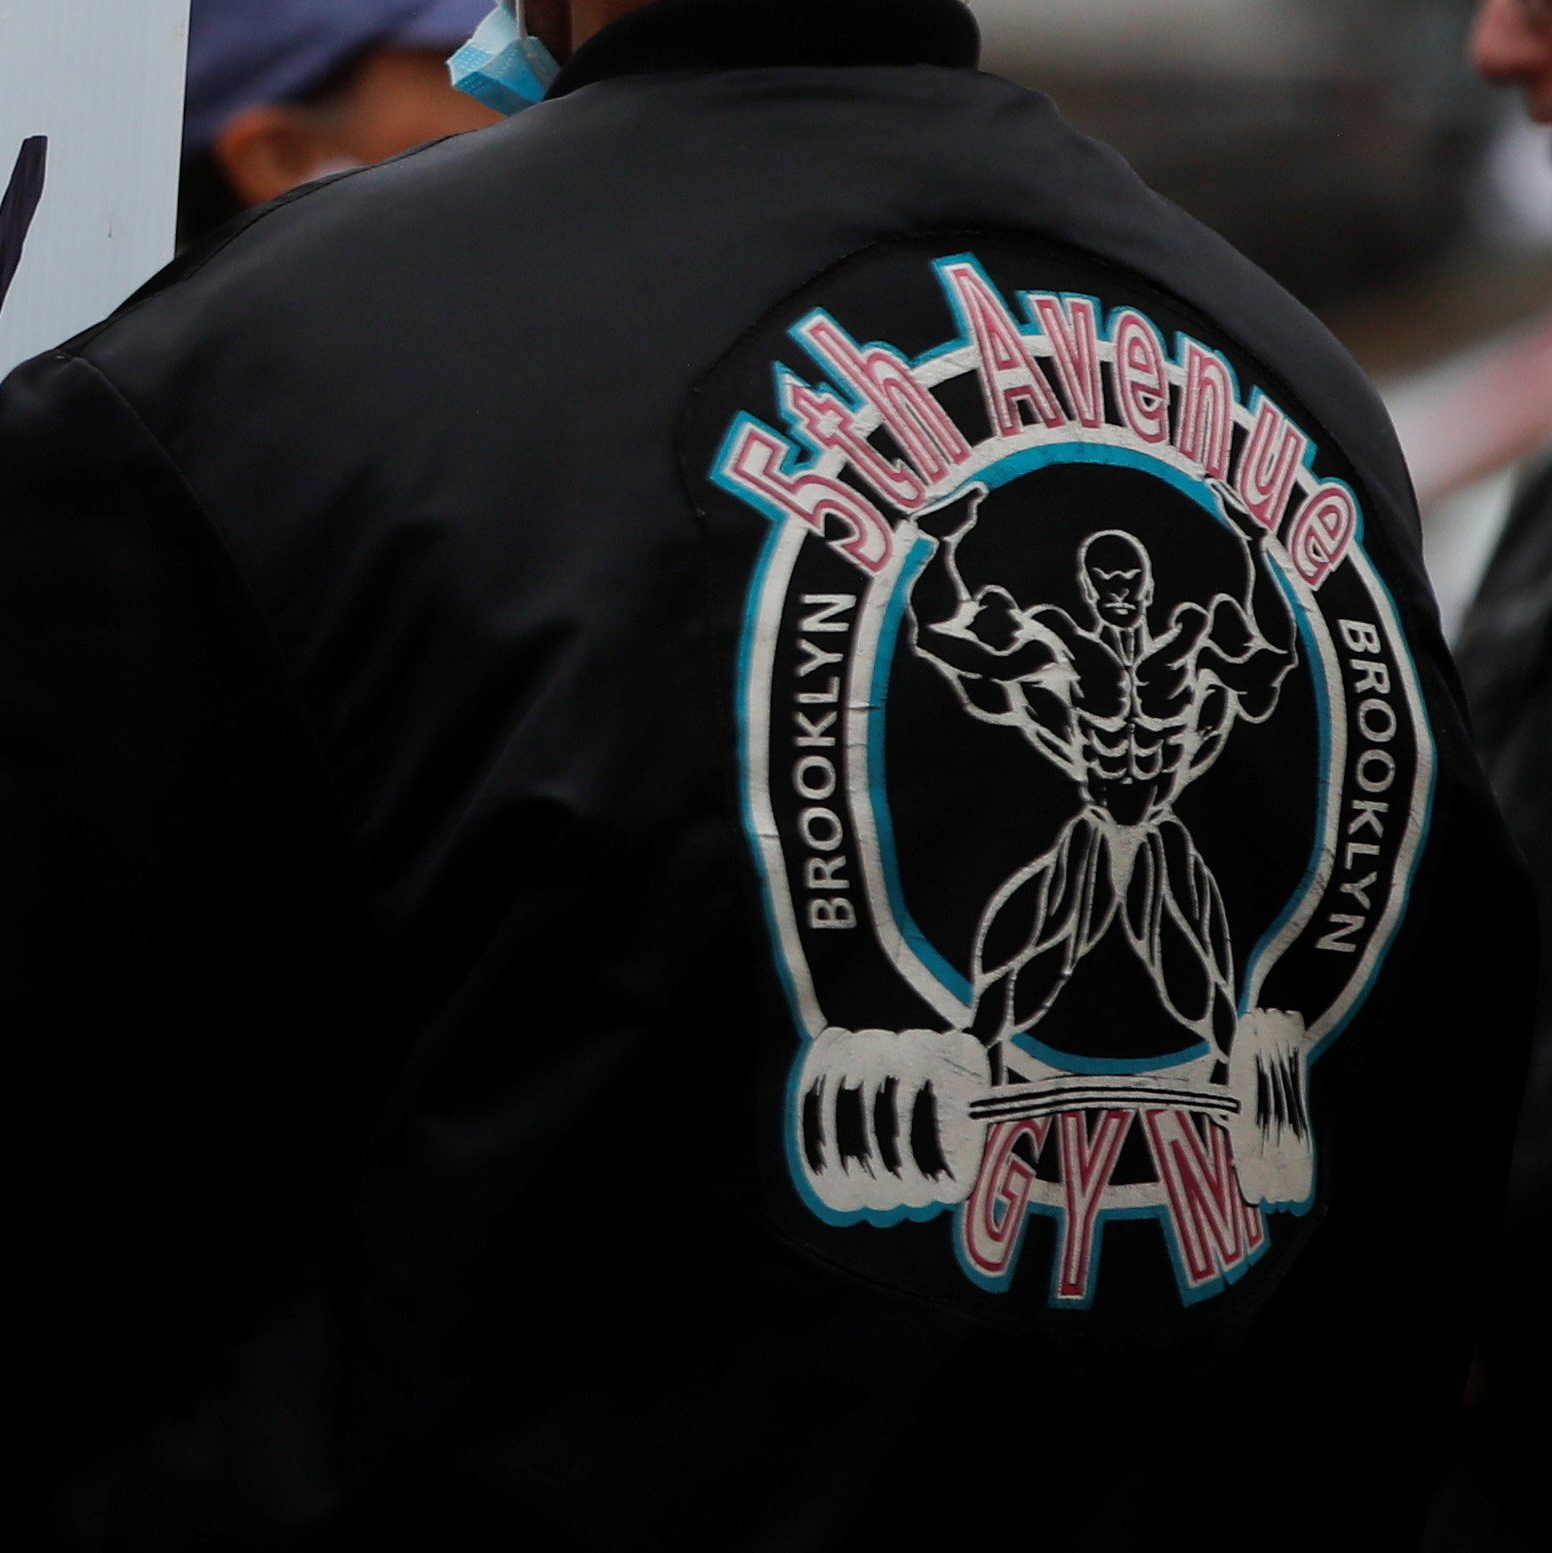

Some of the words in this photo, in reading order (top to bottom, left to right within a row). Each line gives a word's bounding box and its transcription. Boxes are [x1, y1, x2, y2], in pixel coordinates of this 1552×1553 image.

[717, 308, 974, 574] 5th
[937, 258, 1361, 584] Avenue
[795, 593, 858, 929] BROOKLYN
[1315, 617, 1397, 953] BROOKLYN
[963, 1104, 1266, 1300] GYM
